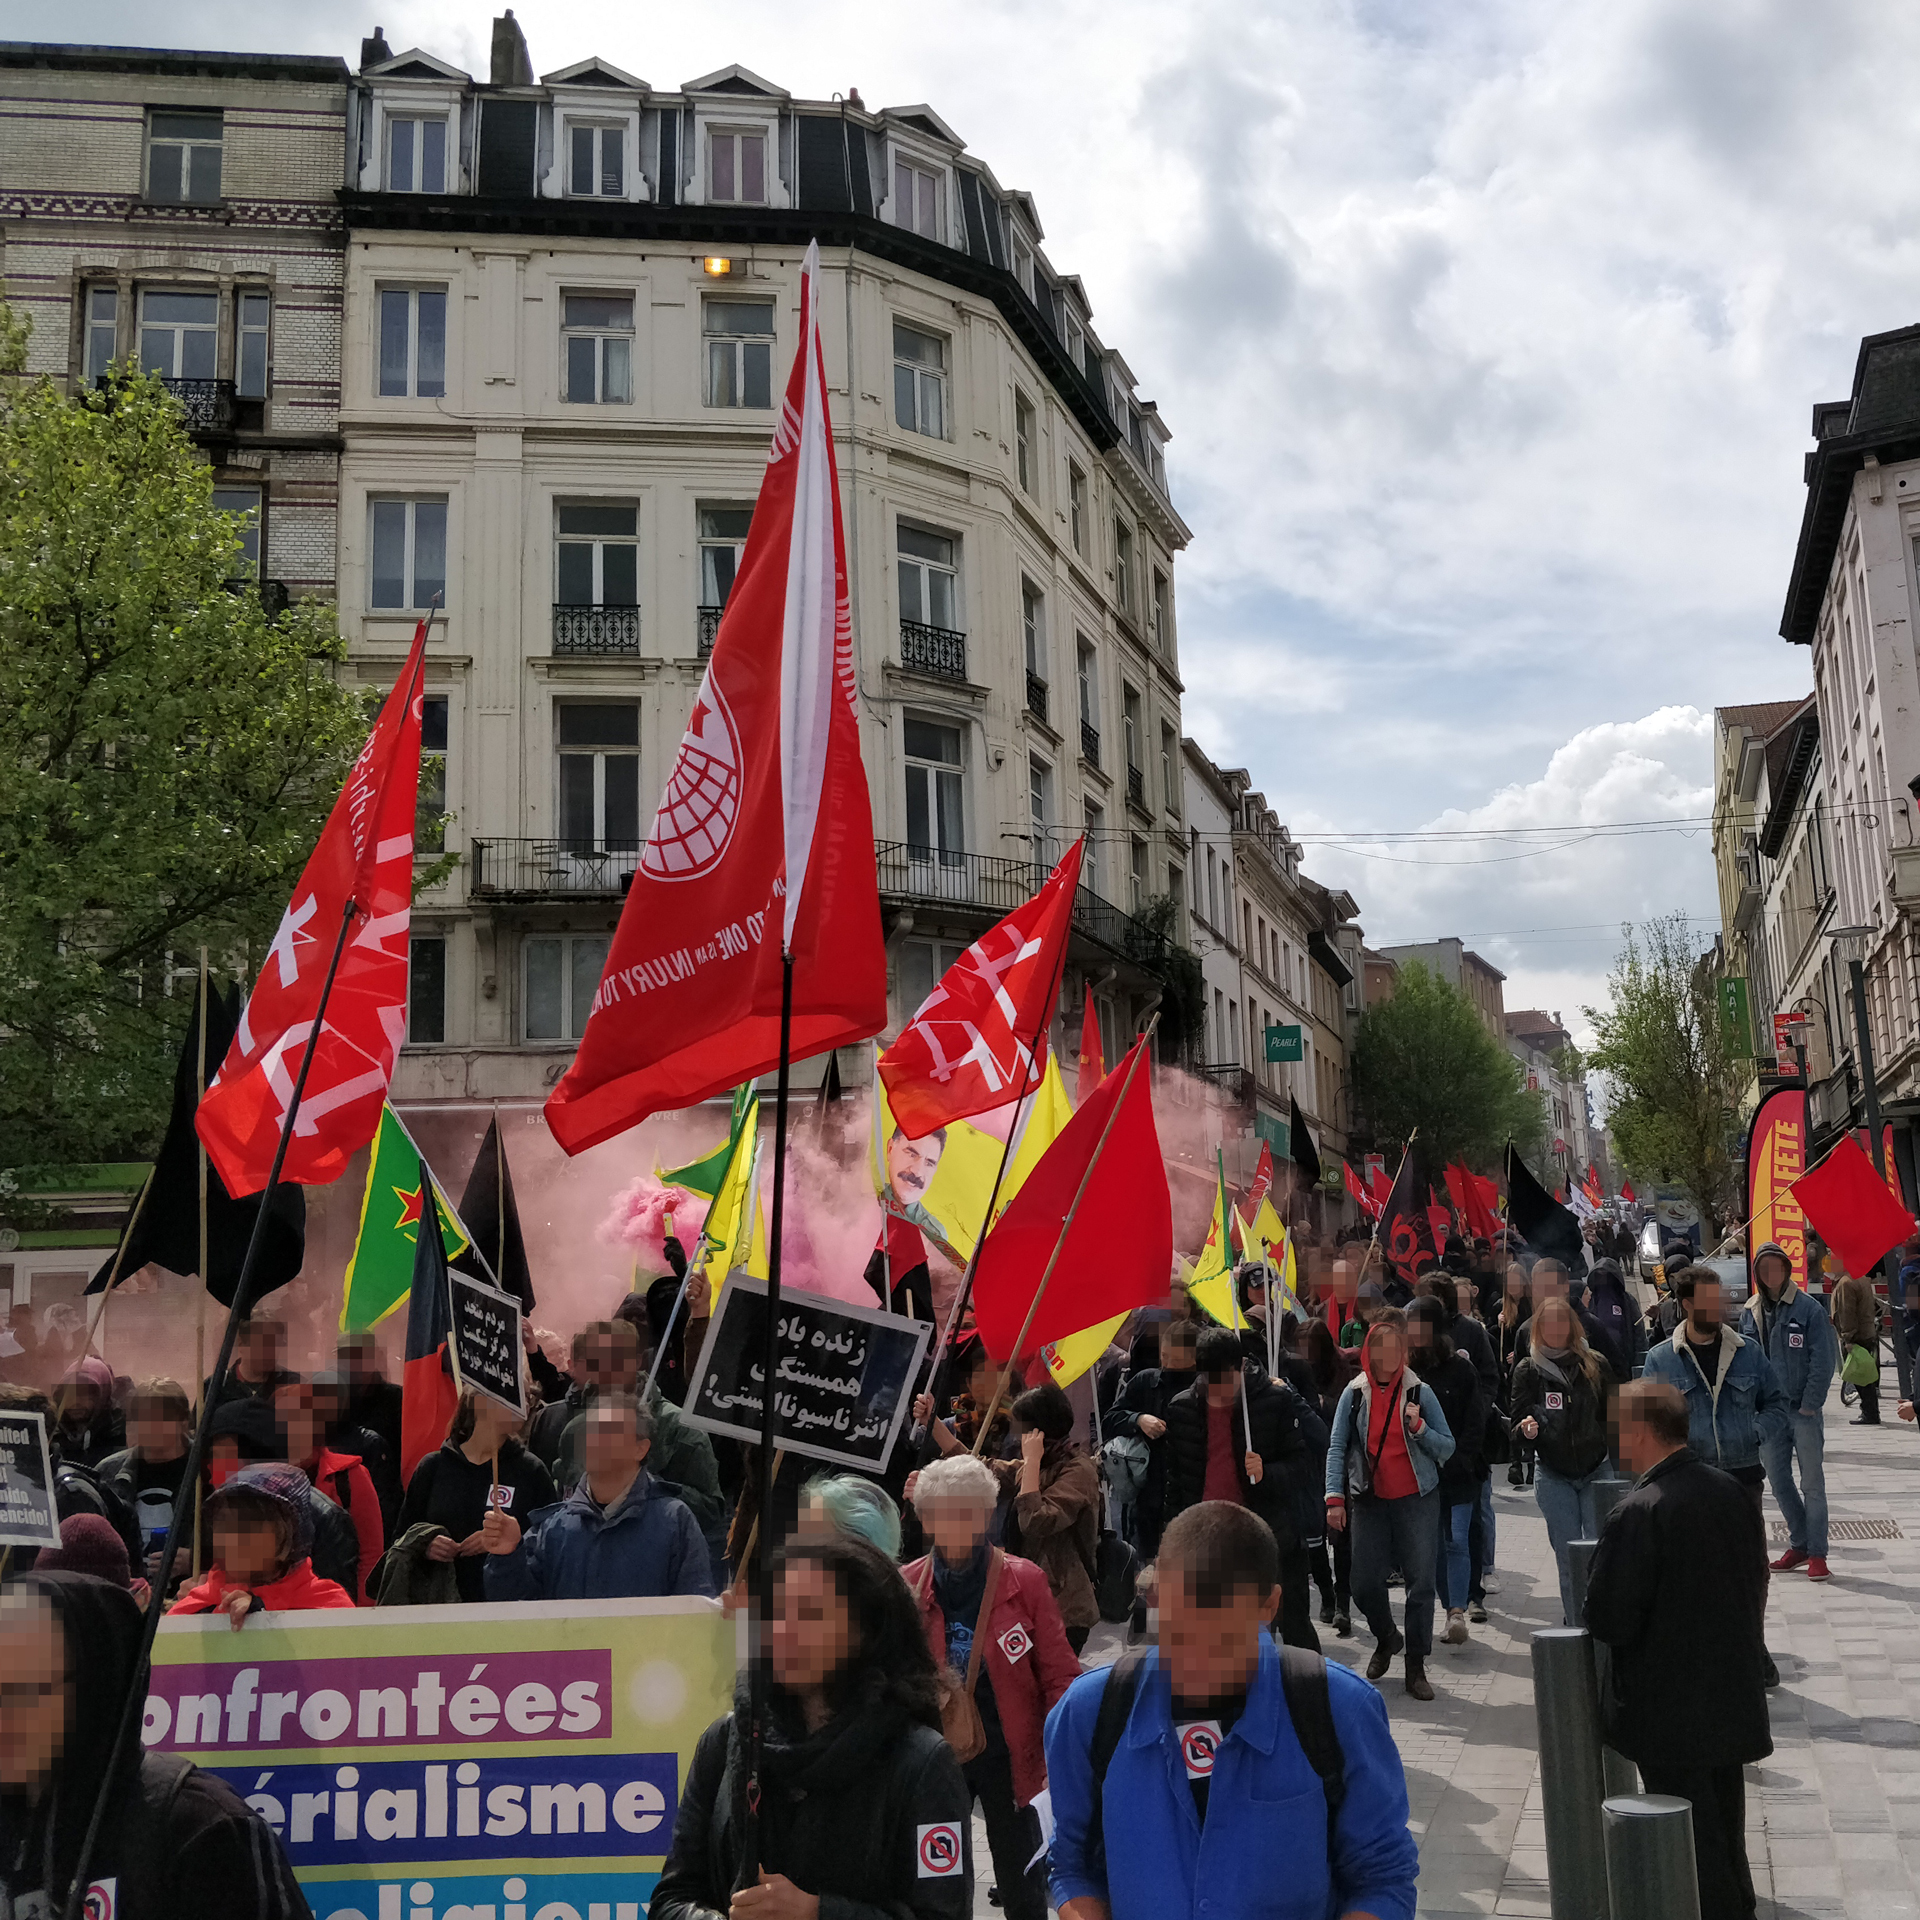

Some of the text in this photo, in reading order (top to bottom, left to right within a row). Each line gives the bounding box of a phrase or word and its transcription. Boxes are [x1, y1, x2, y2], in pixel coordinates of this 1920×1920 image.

[1271, 1037, 1297, 1047] PEARLE
[1774, 1119, 1800, 1180] FETE
[464, 1299, 506, 1335] مردم متحد
[462, 1323, 509, 1362] هرگز شکست
[776, 1315, 867, 1366] زنده باد
[0, 1487, 32, 1506] nido,
[0, 1509, 48, 1527] encido!
[141, 1663, 602, 1746] onfrontées
[249, 1761, 666, 1843] érialisme
